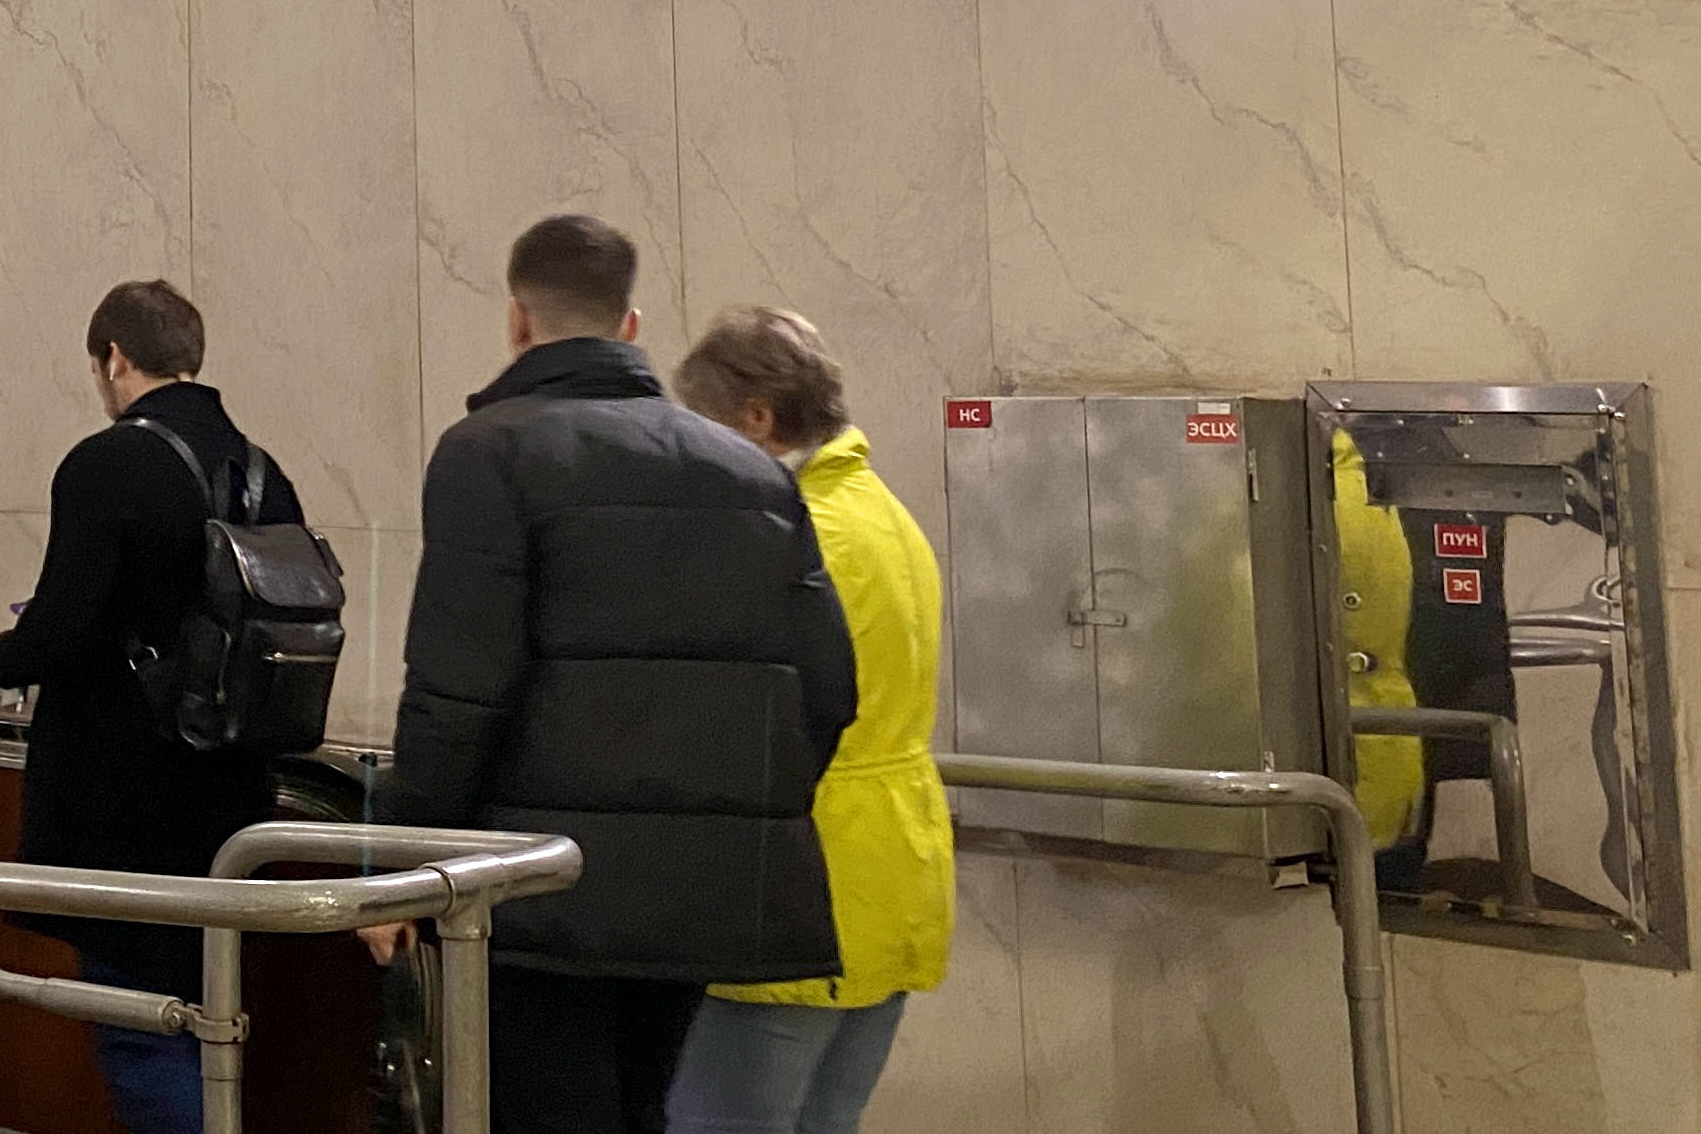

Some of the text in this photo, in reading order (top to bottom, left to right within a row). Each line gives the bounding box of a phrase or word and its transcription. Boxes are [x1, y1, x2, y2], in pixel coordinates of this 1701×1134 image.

[959, 408, 981, 422] НС
[1187, 422, 1237, 439] ЭСЦХ
[1442, 532, 1479, 547] ПУН
[1452, 579, 1473, 592] ЭС
